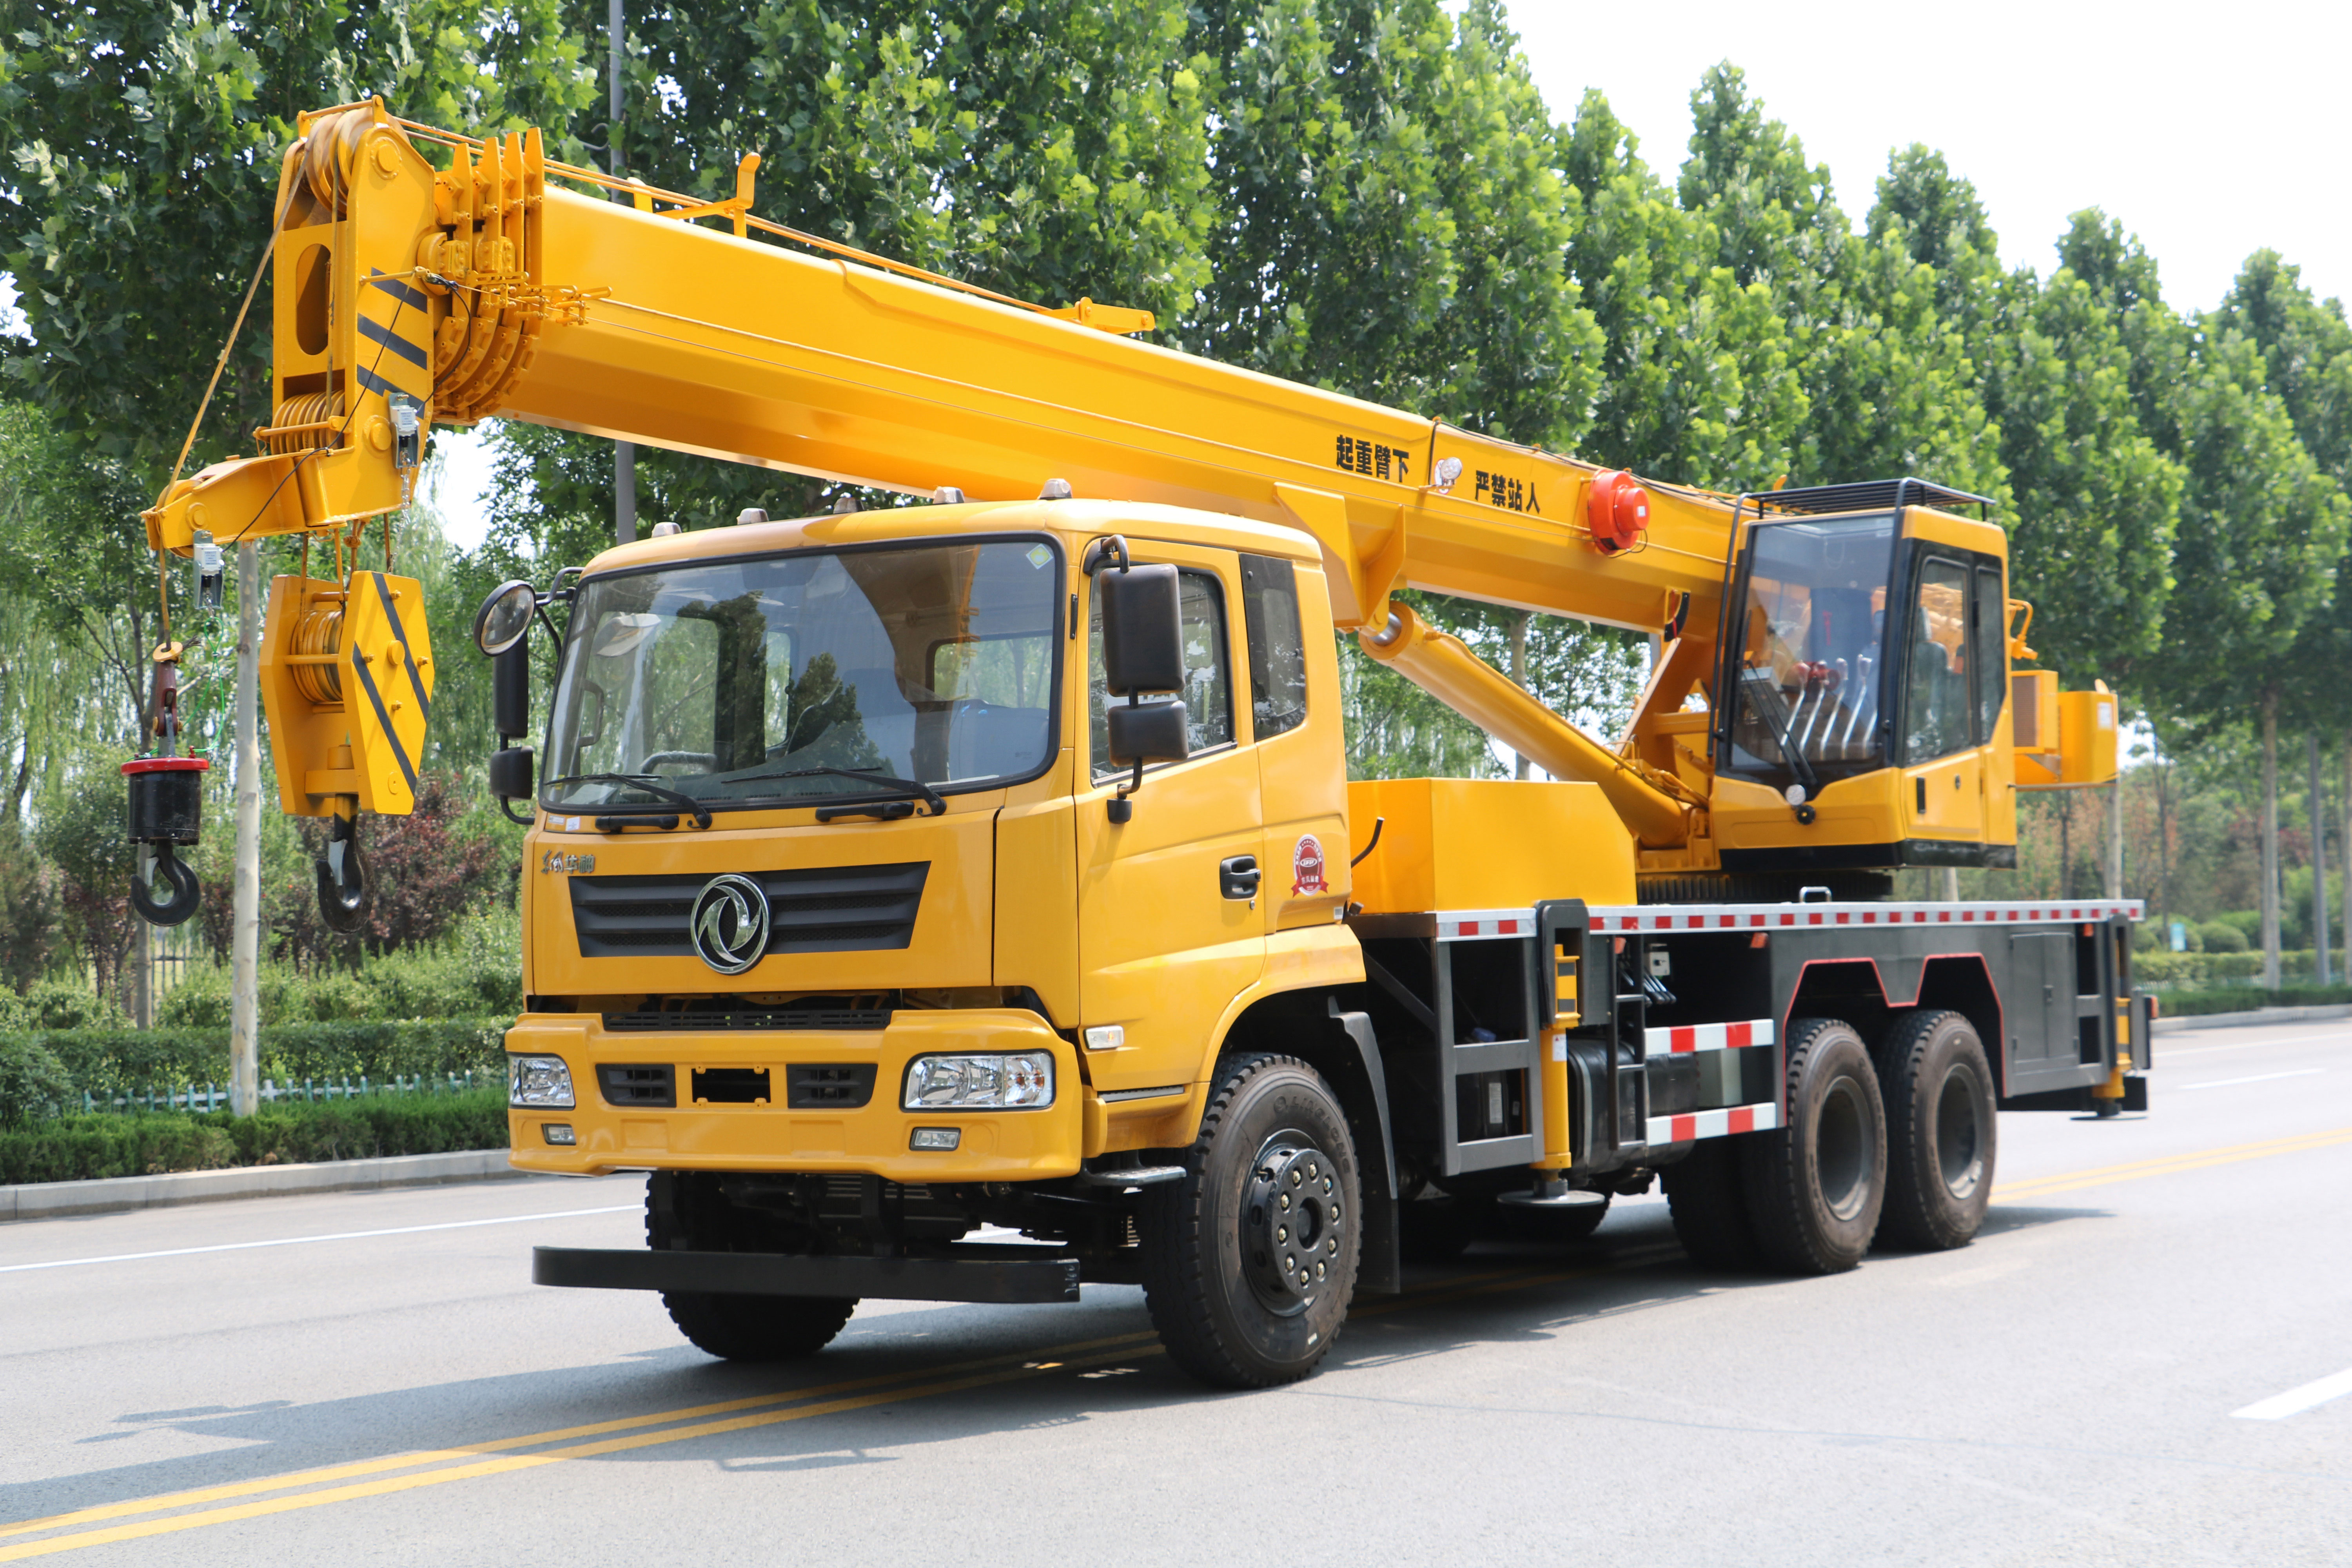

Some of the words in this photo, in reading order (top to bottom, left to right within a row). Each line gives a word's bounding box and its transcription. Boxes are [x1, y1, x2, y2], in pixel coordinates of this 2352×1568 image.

[1336, 434, 1409, 483] 起重臂下
[1475, 470, 1541, 514] 严禁站人
